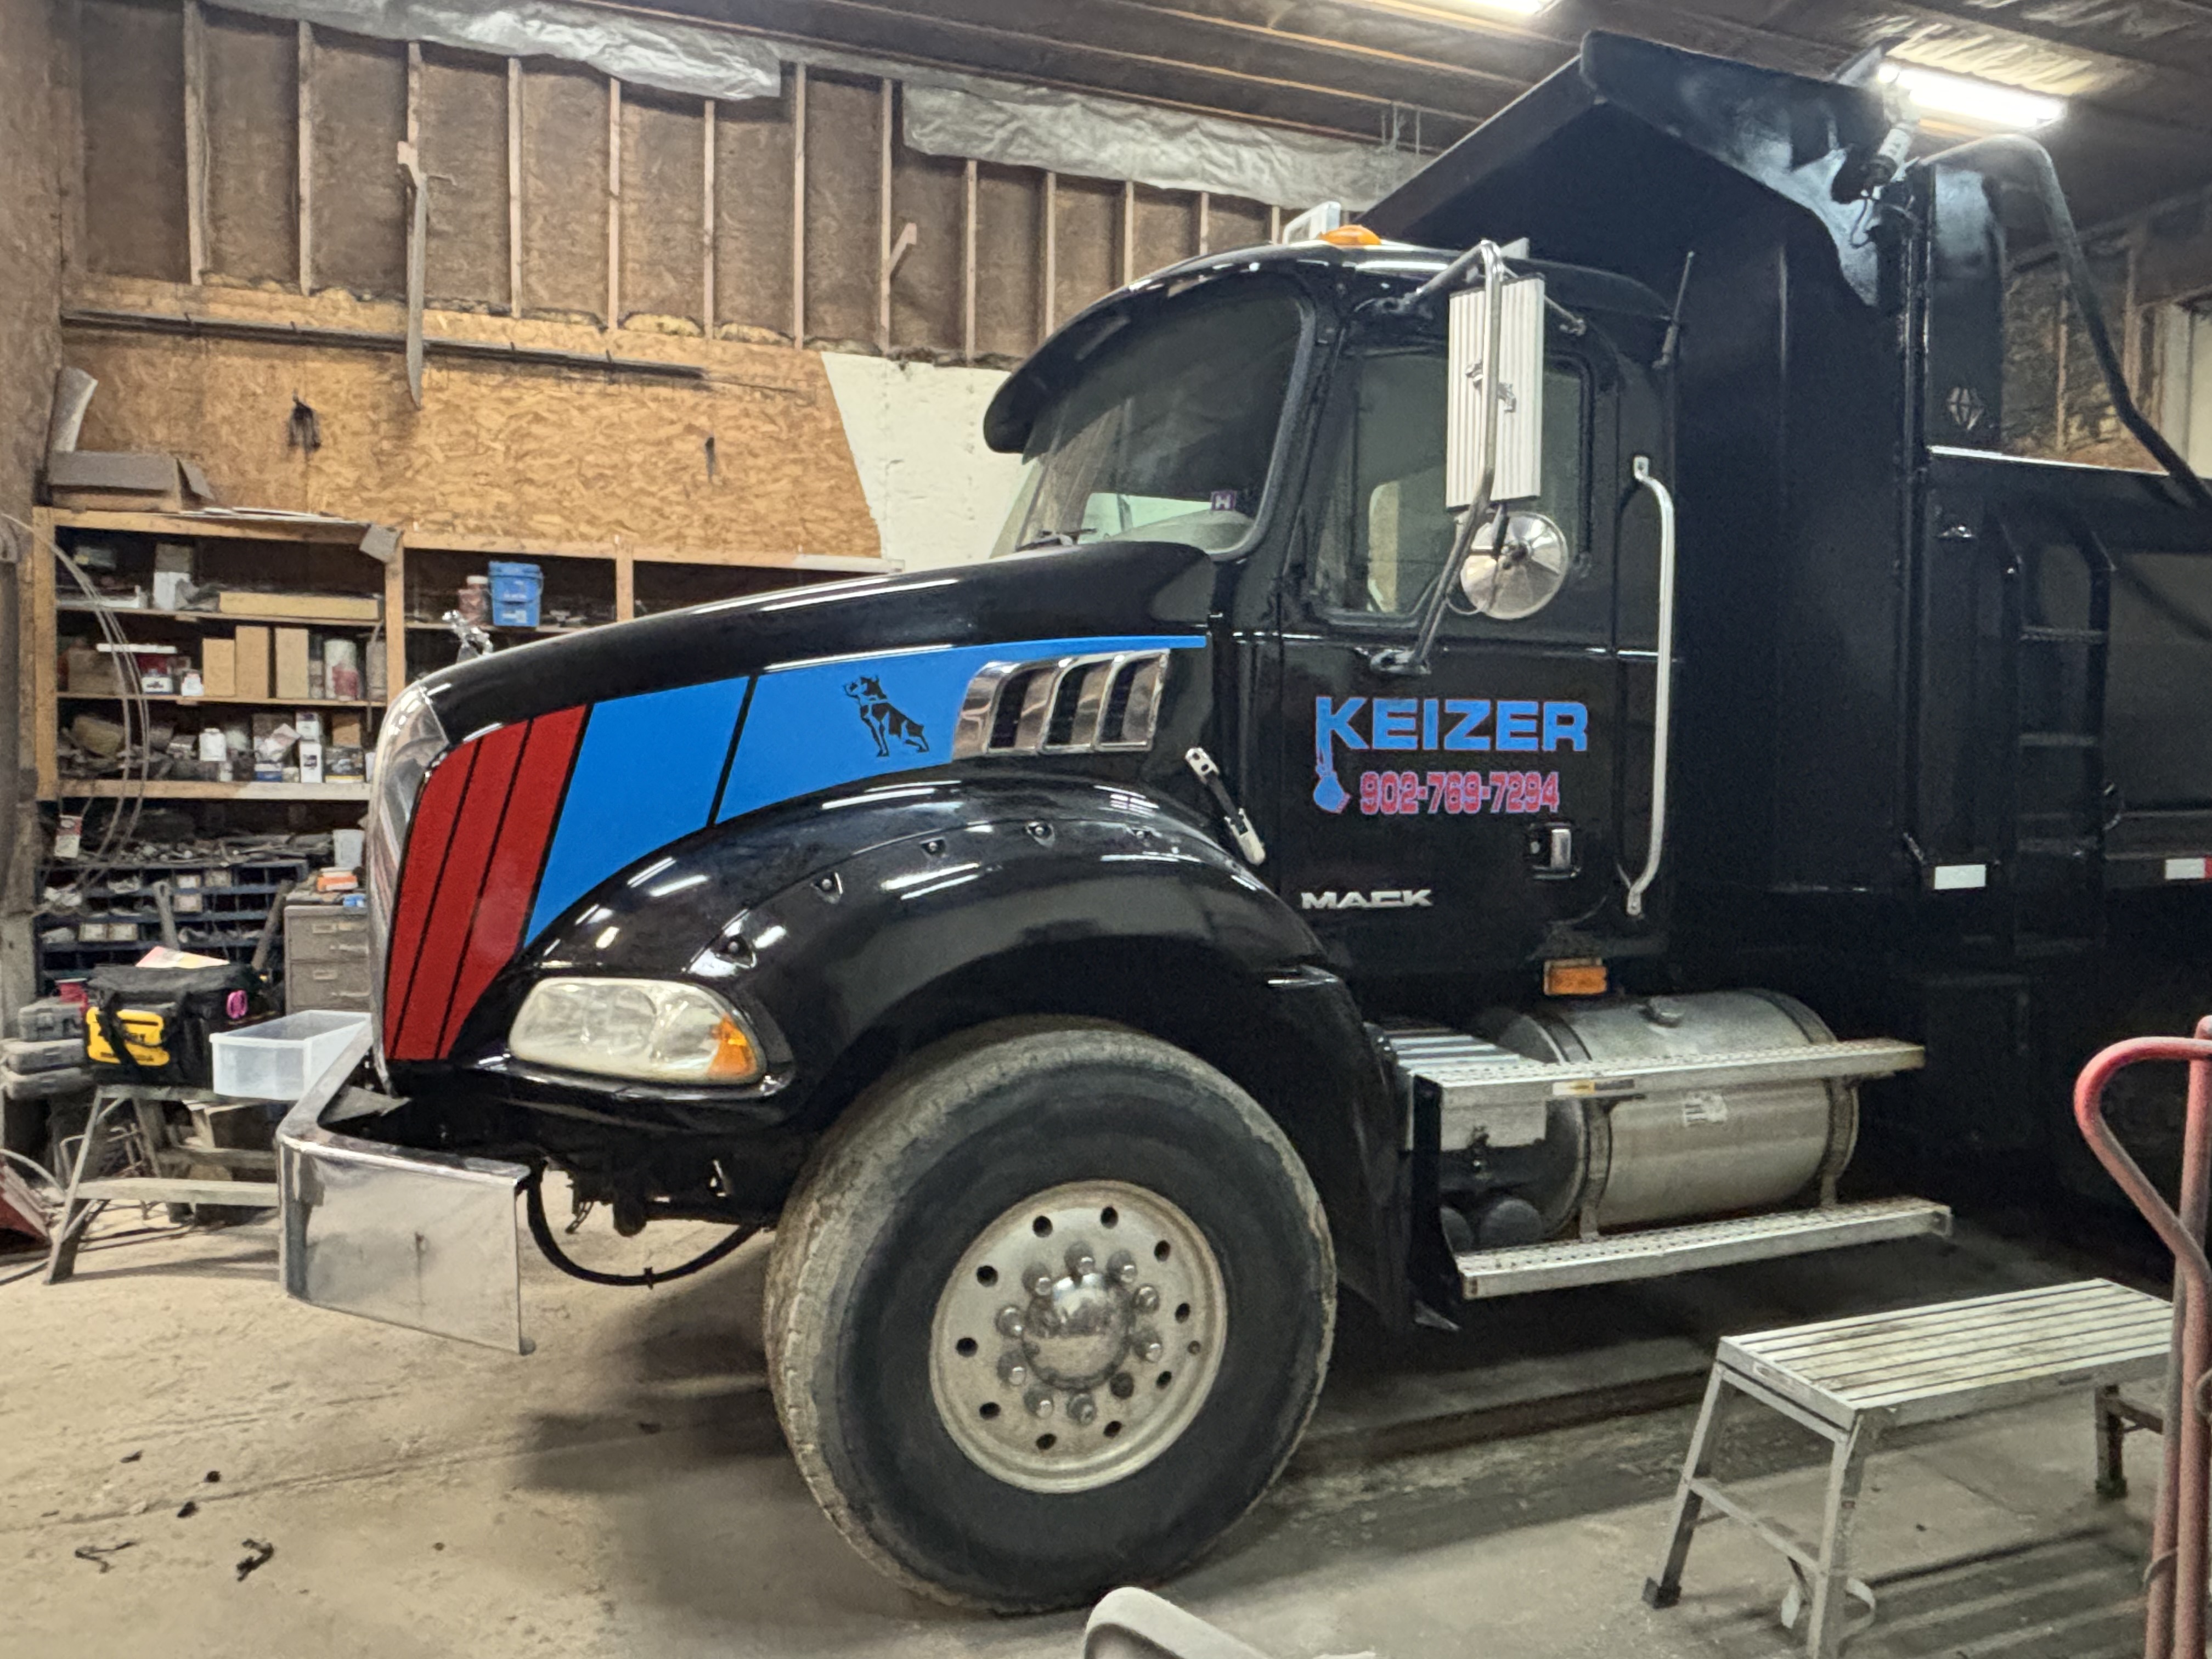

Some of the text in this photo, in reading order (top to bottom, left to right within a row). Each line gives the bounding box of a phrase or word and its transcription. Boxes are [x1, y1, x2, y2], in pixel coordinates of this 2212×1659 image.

[1315, 696, 1588, 752] KEIZER
[1359, 771, 1560, 815] 902-769-7294
[1301, 889, 1434, 909] MACK
